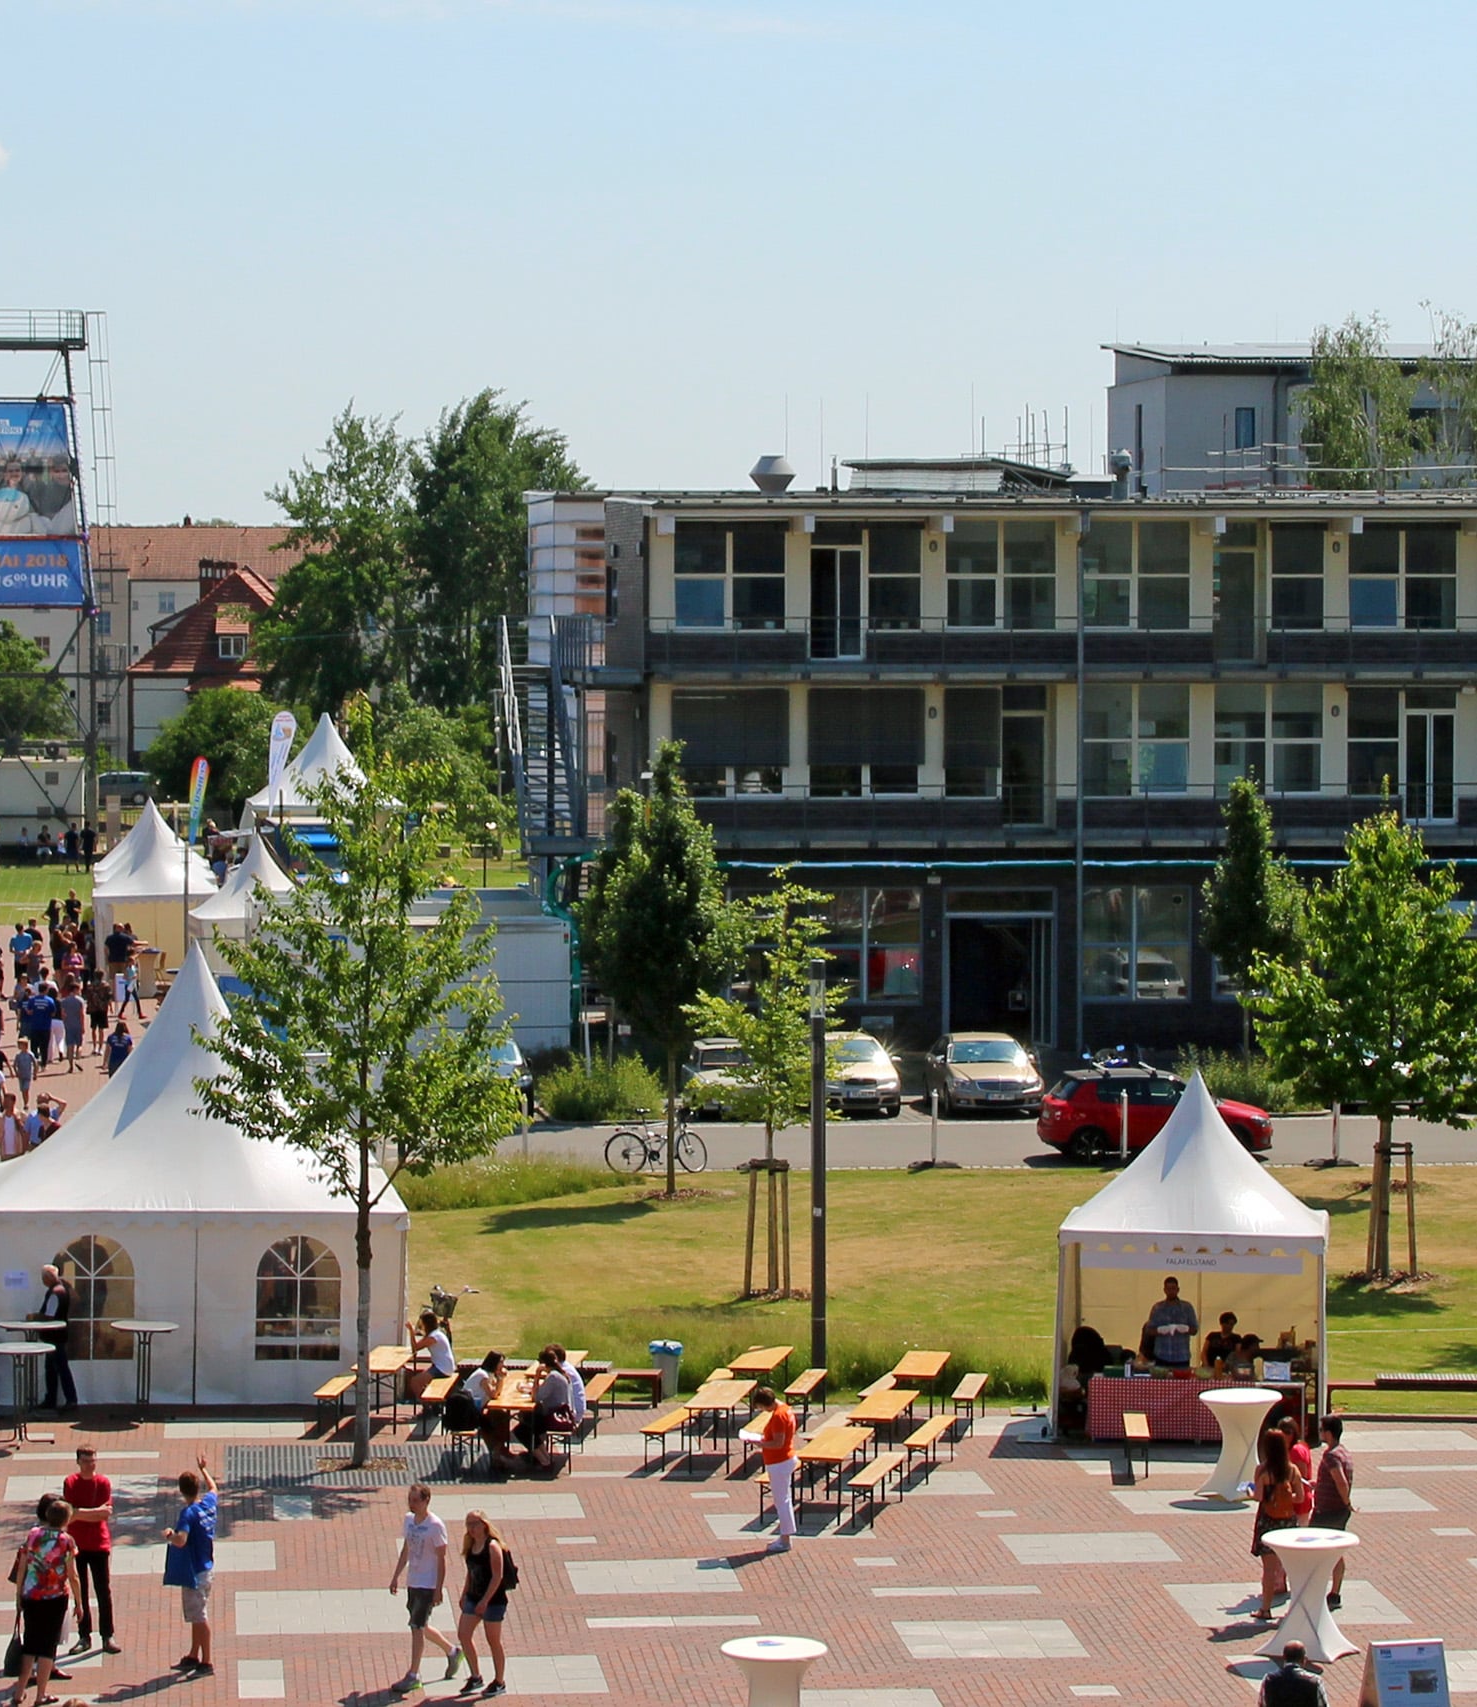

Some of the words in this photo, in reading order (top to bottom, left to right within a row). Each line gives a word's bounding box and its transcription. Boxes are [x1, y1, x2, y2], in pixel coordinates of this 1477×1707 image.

[25, 554, 68, 568] 2018
[30, 574, 68, 587] UHR
[1166, 1258, 1217, 1266] FALAFELSTAND
